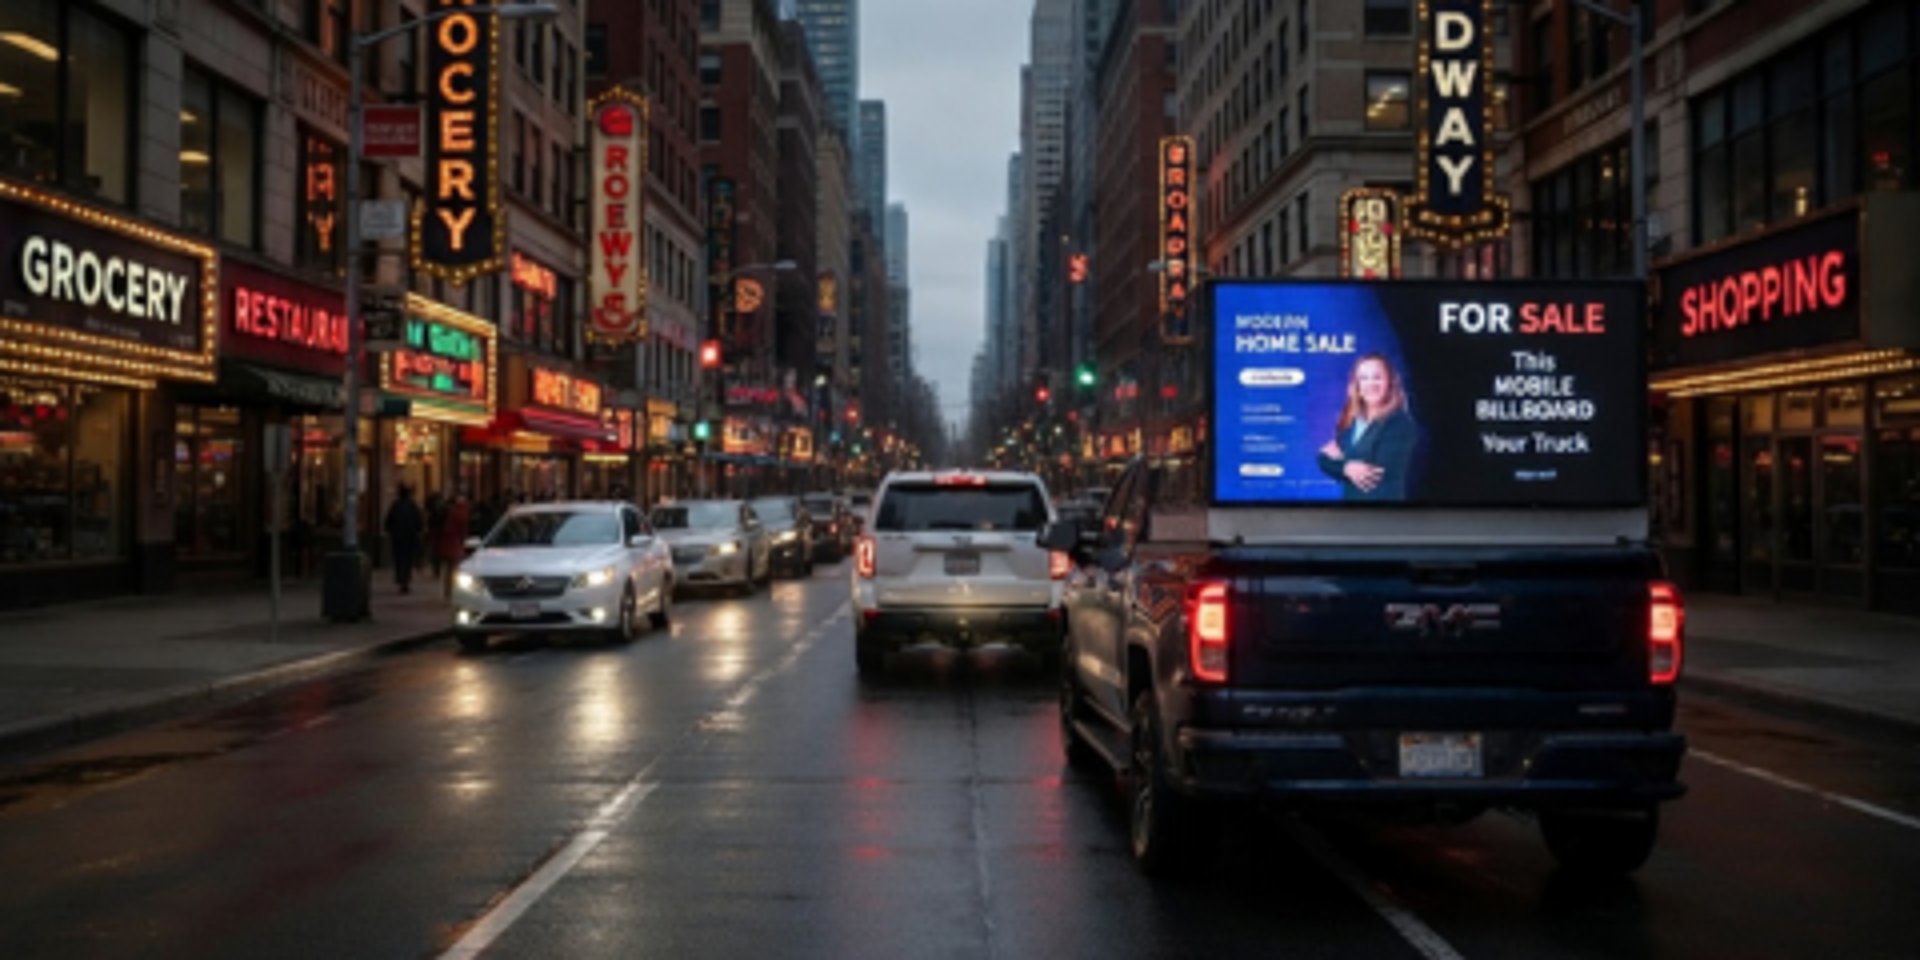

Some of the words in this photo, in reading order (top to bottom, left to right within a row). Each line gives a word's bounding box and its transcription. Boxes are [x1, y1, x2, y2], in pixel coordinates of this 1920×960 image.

[1431, 12, 1477, 193] DWAY
[438, 0, 478, 250] OCERY
[22, 236, 188, 323] GROCERY
[1681, 251, 1845, 336] SHOPPING
[236, 287, 349, 352] RESTAURA
[1440, 303, 1511, 333] FOR
[1520, 303, 1605, 333] SALE
[1236, 334, 1300, 352] HOME
[1305, 334, 1355, 353] SALE
[1512, 351, 1556, 372] This
[1495, 375, 1573, 396] MOBILE
[1476, 399, 1595, 420] BILLBOARD
[1482, 433, 1527, 453] Your
[1532, 432, 1589, 453] Truck
